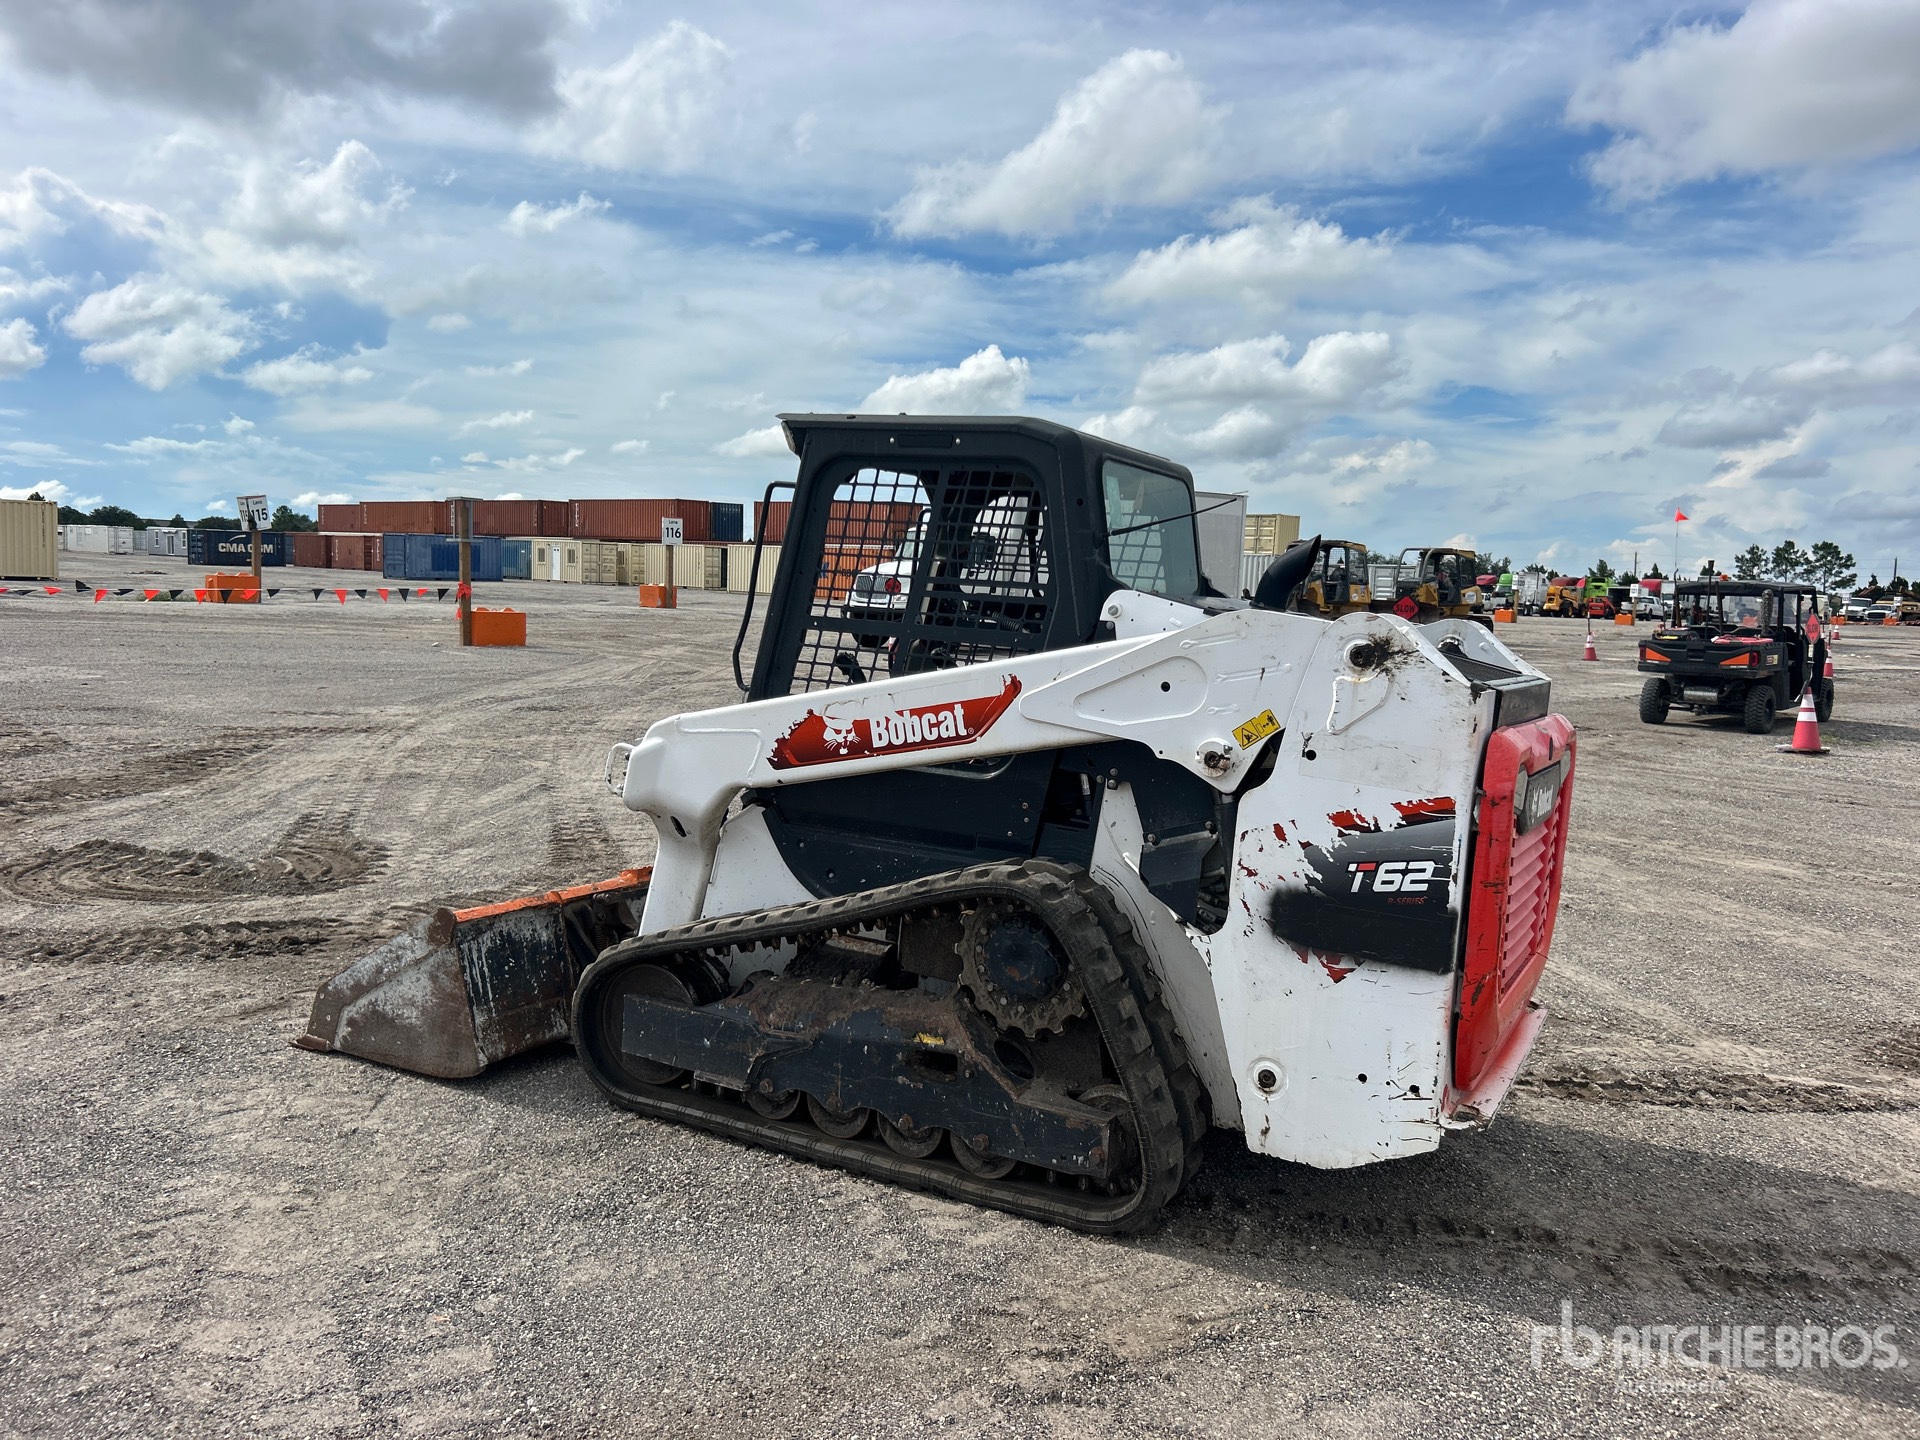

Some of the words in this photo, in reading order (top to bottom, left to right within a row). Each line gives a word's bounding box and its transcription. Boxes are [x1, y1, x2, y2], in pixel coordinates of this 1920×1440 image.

[665, 526, 682, 539] 116
[218, 542, 246, 553] CMA
[1395, 604, 1416, 614] SLOW
[868, 703, 968, 748] Bobcat
[1347, 860, 1436, 893] T62
